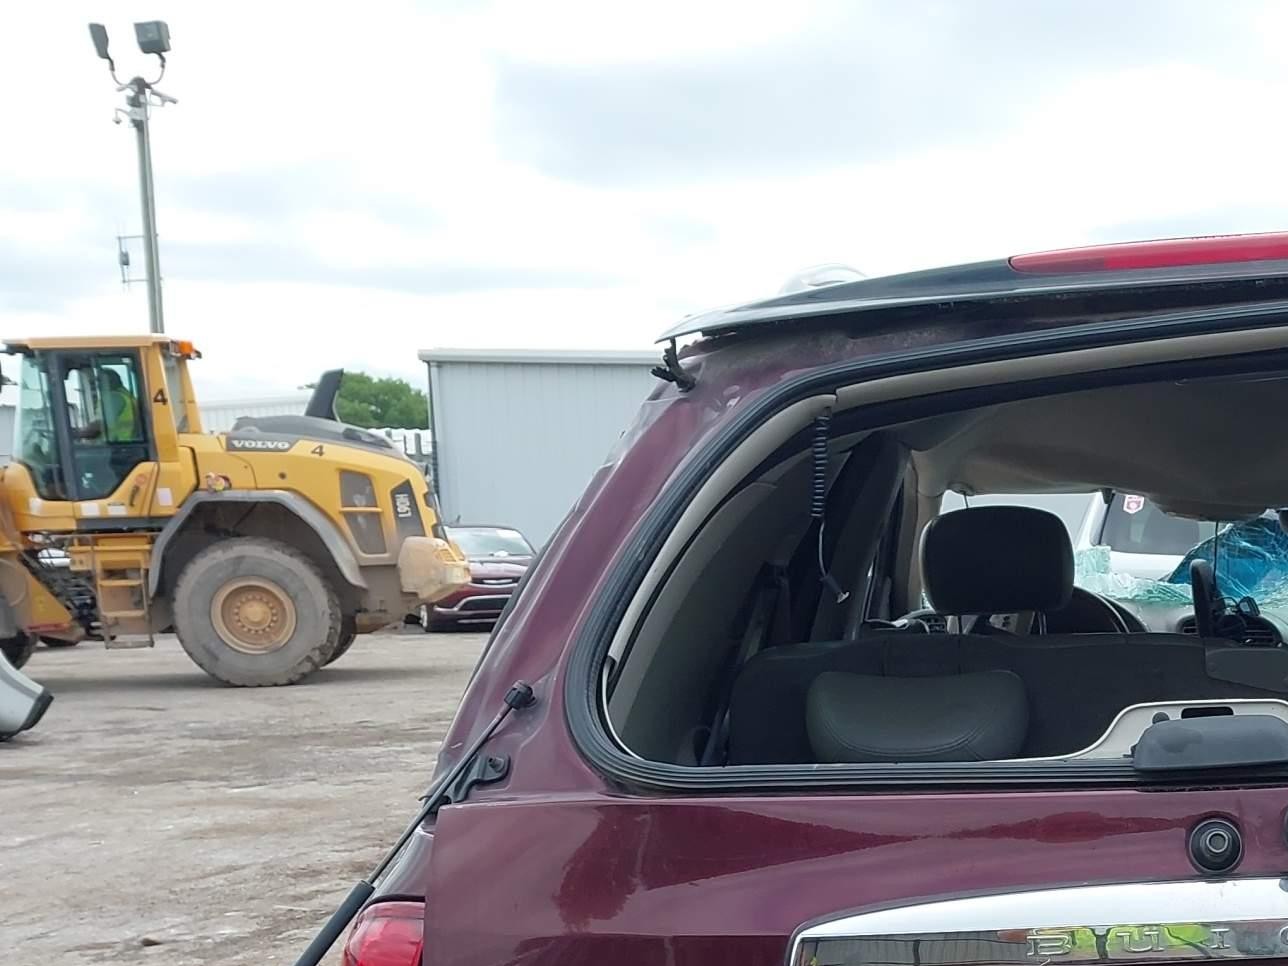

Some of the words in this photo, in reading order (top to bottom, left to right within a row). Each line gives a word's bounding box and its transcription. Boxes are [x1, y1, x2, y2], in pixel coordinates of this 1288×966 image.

[153, 389, 168, 405] 4
[231, 439, 290, 449] VOLVO
[311, 445, 325, 457] 4
